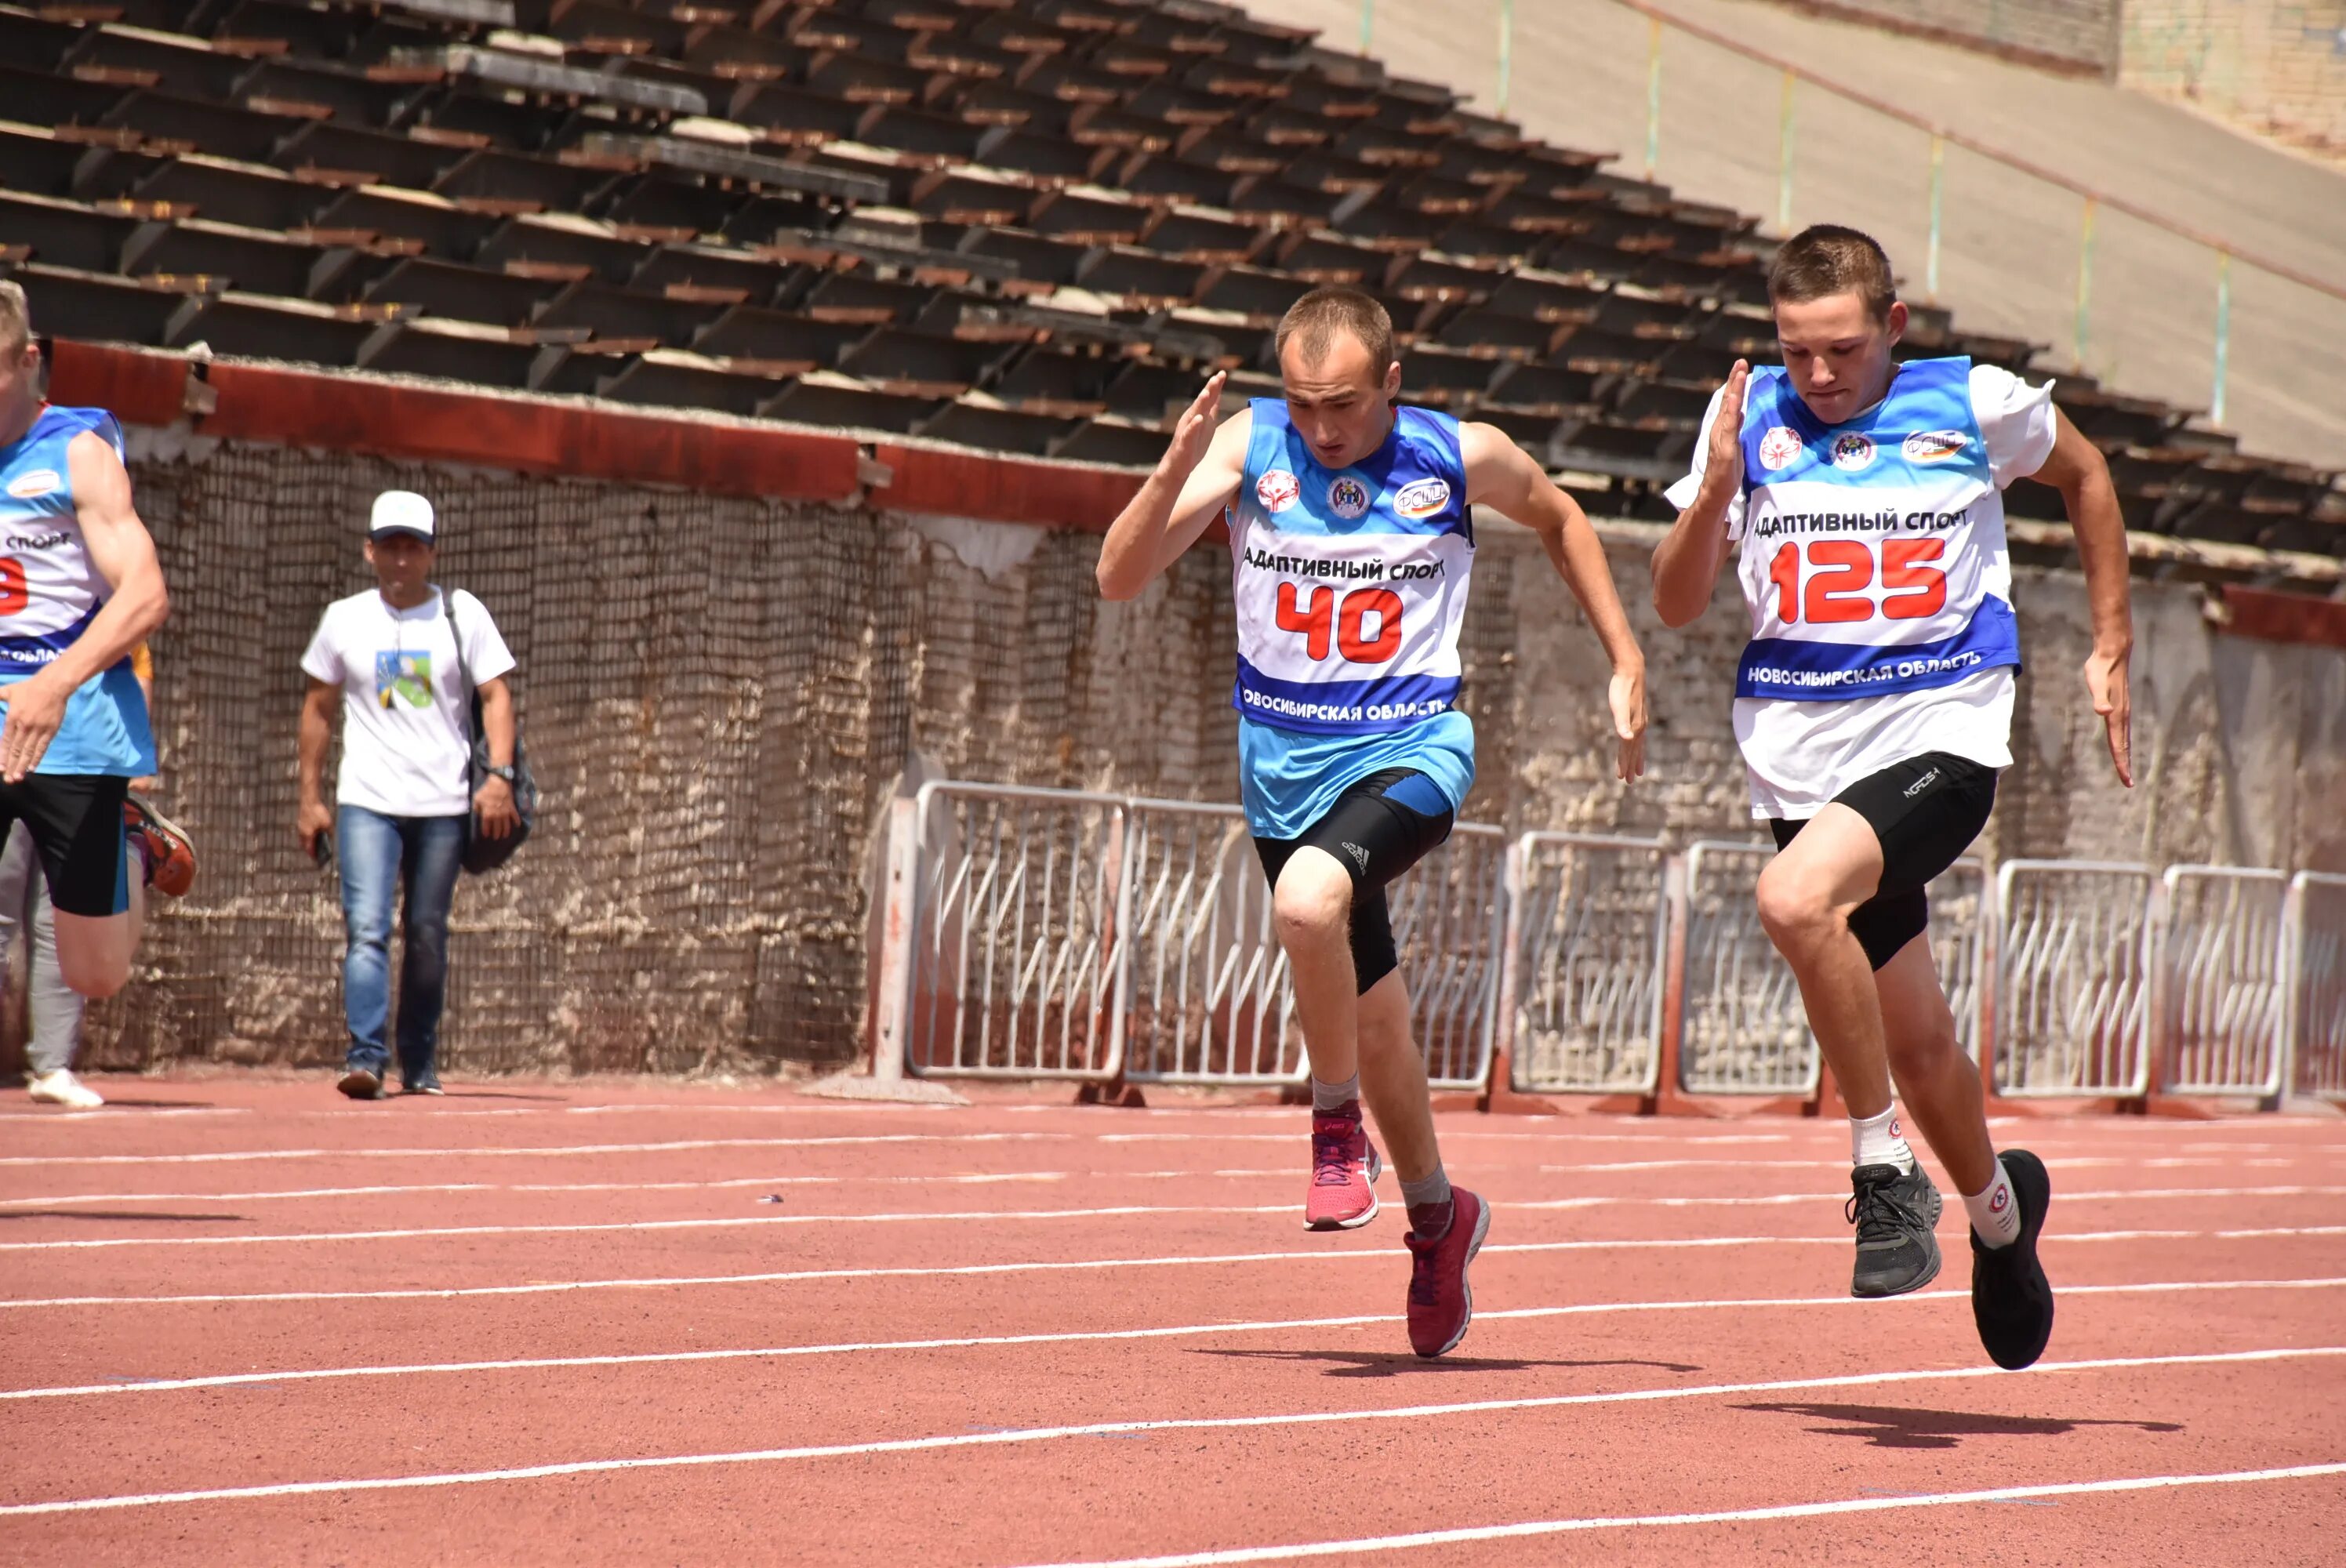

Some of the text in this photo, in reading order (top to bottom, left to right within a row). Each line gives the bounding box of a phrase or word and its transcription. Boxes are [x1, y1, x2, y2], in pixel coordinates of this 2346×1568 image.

[5, 532, 71, 549] СПОРТ
[1753, 507, 1968, 539] АДАПТИВНЫЙ СПОРТ
[1244, 546, 1384, 580] АДАПТИВНЫЙ
[1770, 538, 1947, 624] 125
[1275, 581, 1404, 664] 40
[1748, 651, 1981, 687] НОВОСИБИРСКАЯ ОБЛАСТЬ
[1241, 687, 1447, 721] ОВОСИБИРСКАЯ ОБЛАСТЬ
[1342, 841, 1367, 877] adidas
